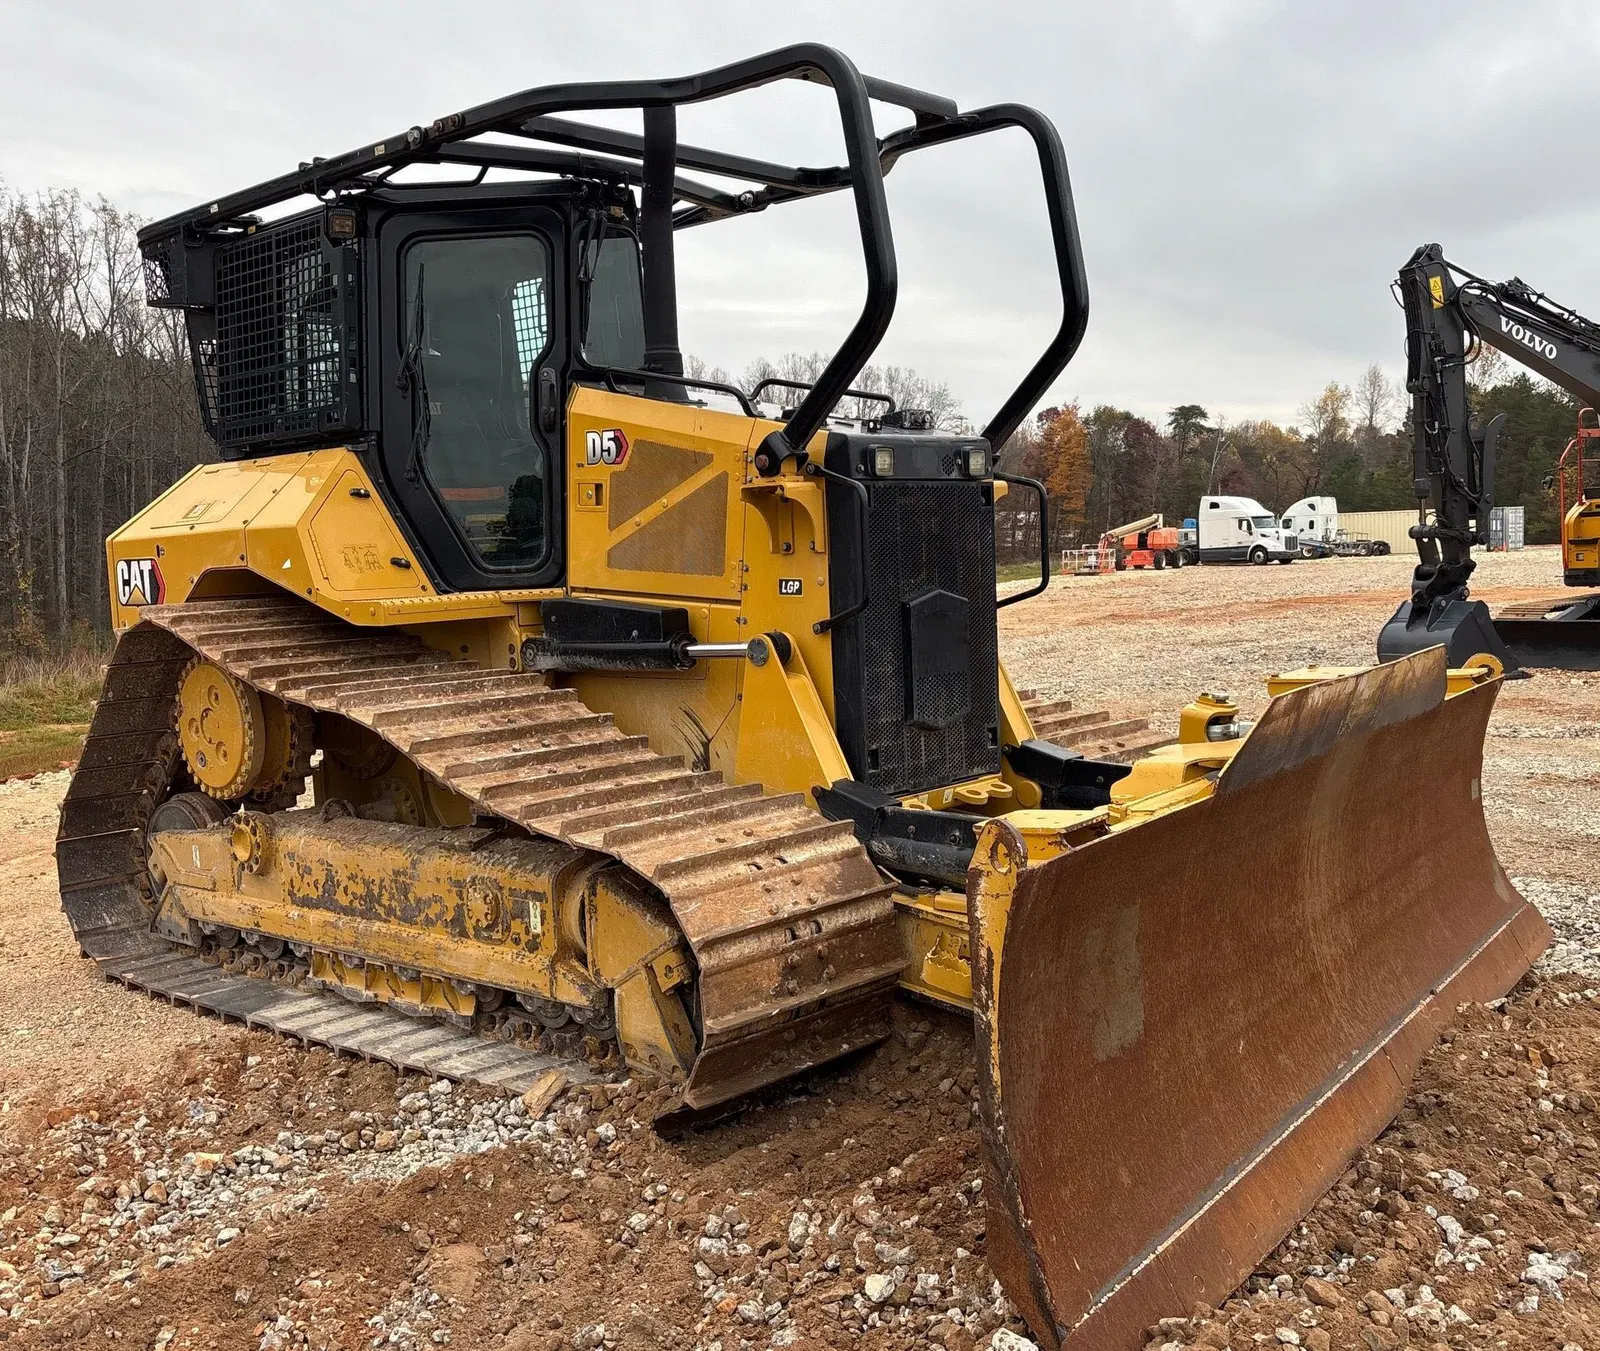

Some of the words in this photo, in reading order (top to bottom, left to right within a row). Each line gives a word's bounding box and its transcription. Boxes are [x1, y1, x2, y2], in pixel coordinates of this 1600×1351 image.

[1500, 315, 1557, 359] VOLVO
[586, 430, 617, 464] D5
[117, 560, 152, 605] CAT
[781, 580, 800, 593] LGP
